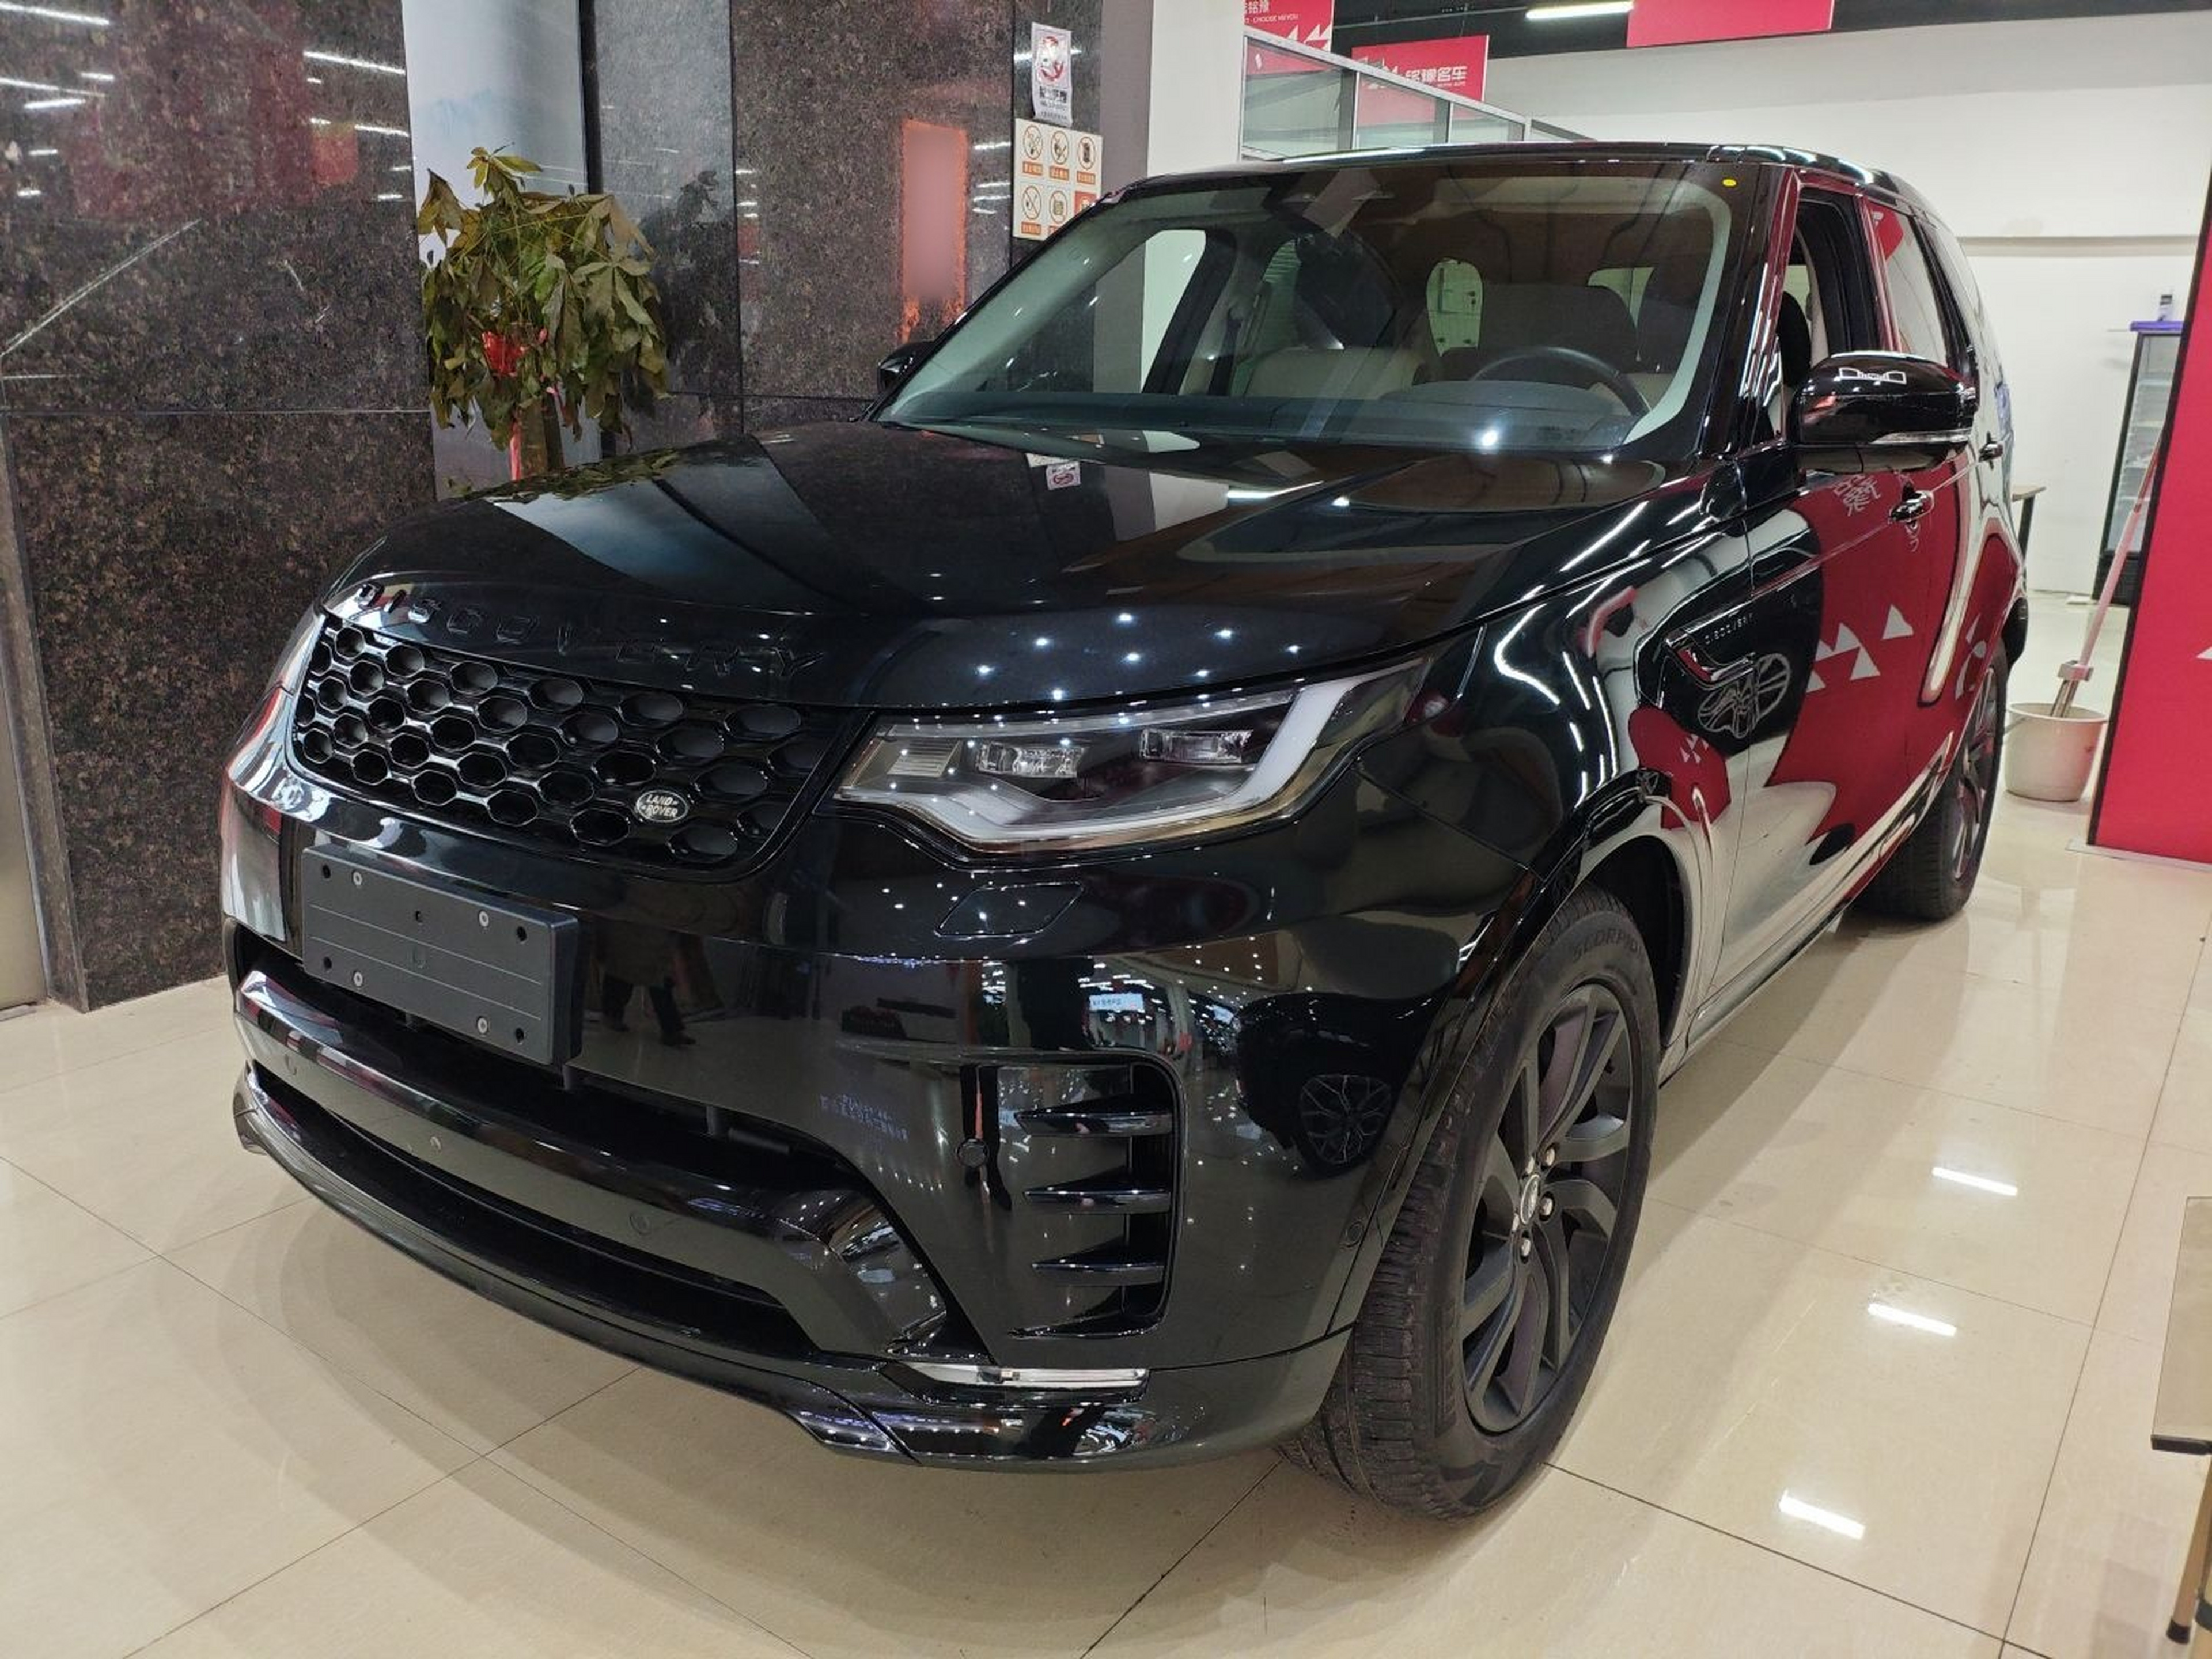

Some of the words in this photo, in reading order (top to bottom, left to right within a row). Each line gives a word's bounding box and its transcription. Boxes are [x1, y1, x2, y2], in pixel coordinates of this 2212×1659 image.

[354, 581, 825, 677] DISCOVERY
[646, 794, 673, 806] LAND
[645, 805, 679, 817] ROVER
